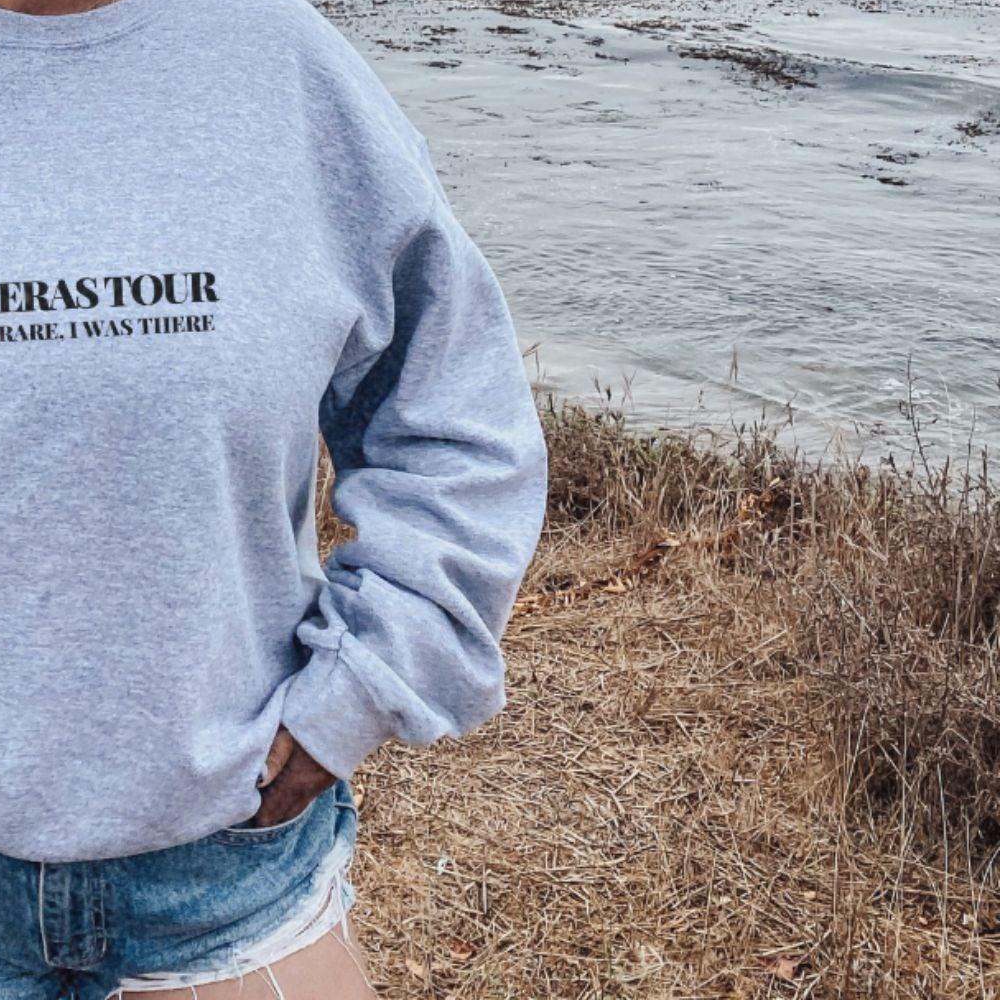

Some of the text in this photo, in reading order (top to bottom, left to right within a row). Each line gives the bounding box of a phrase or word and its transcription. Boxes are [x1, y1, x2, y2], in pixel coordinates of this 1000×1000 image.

[104, 271, 220, 307] TOUR
[69, 321, 79, 339] I
[82, 318, 133, 338] WAS
[138, 314, 215, 335] THERE
